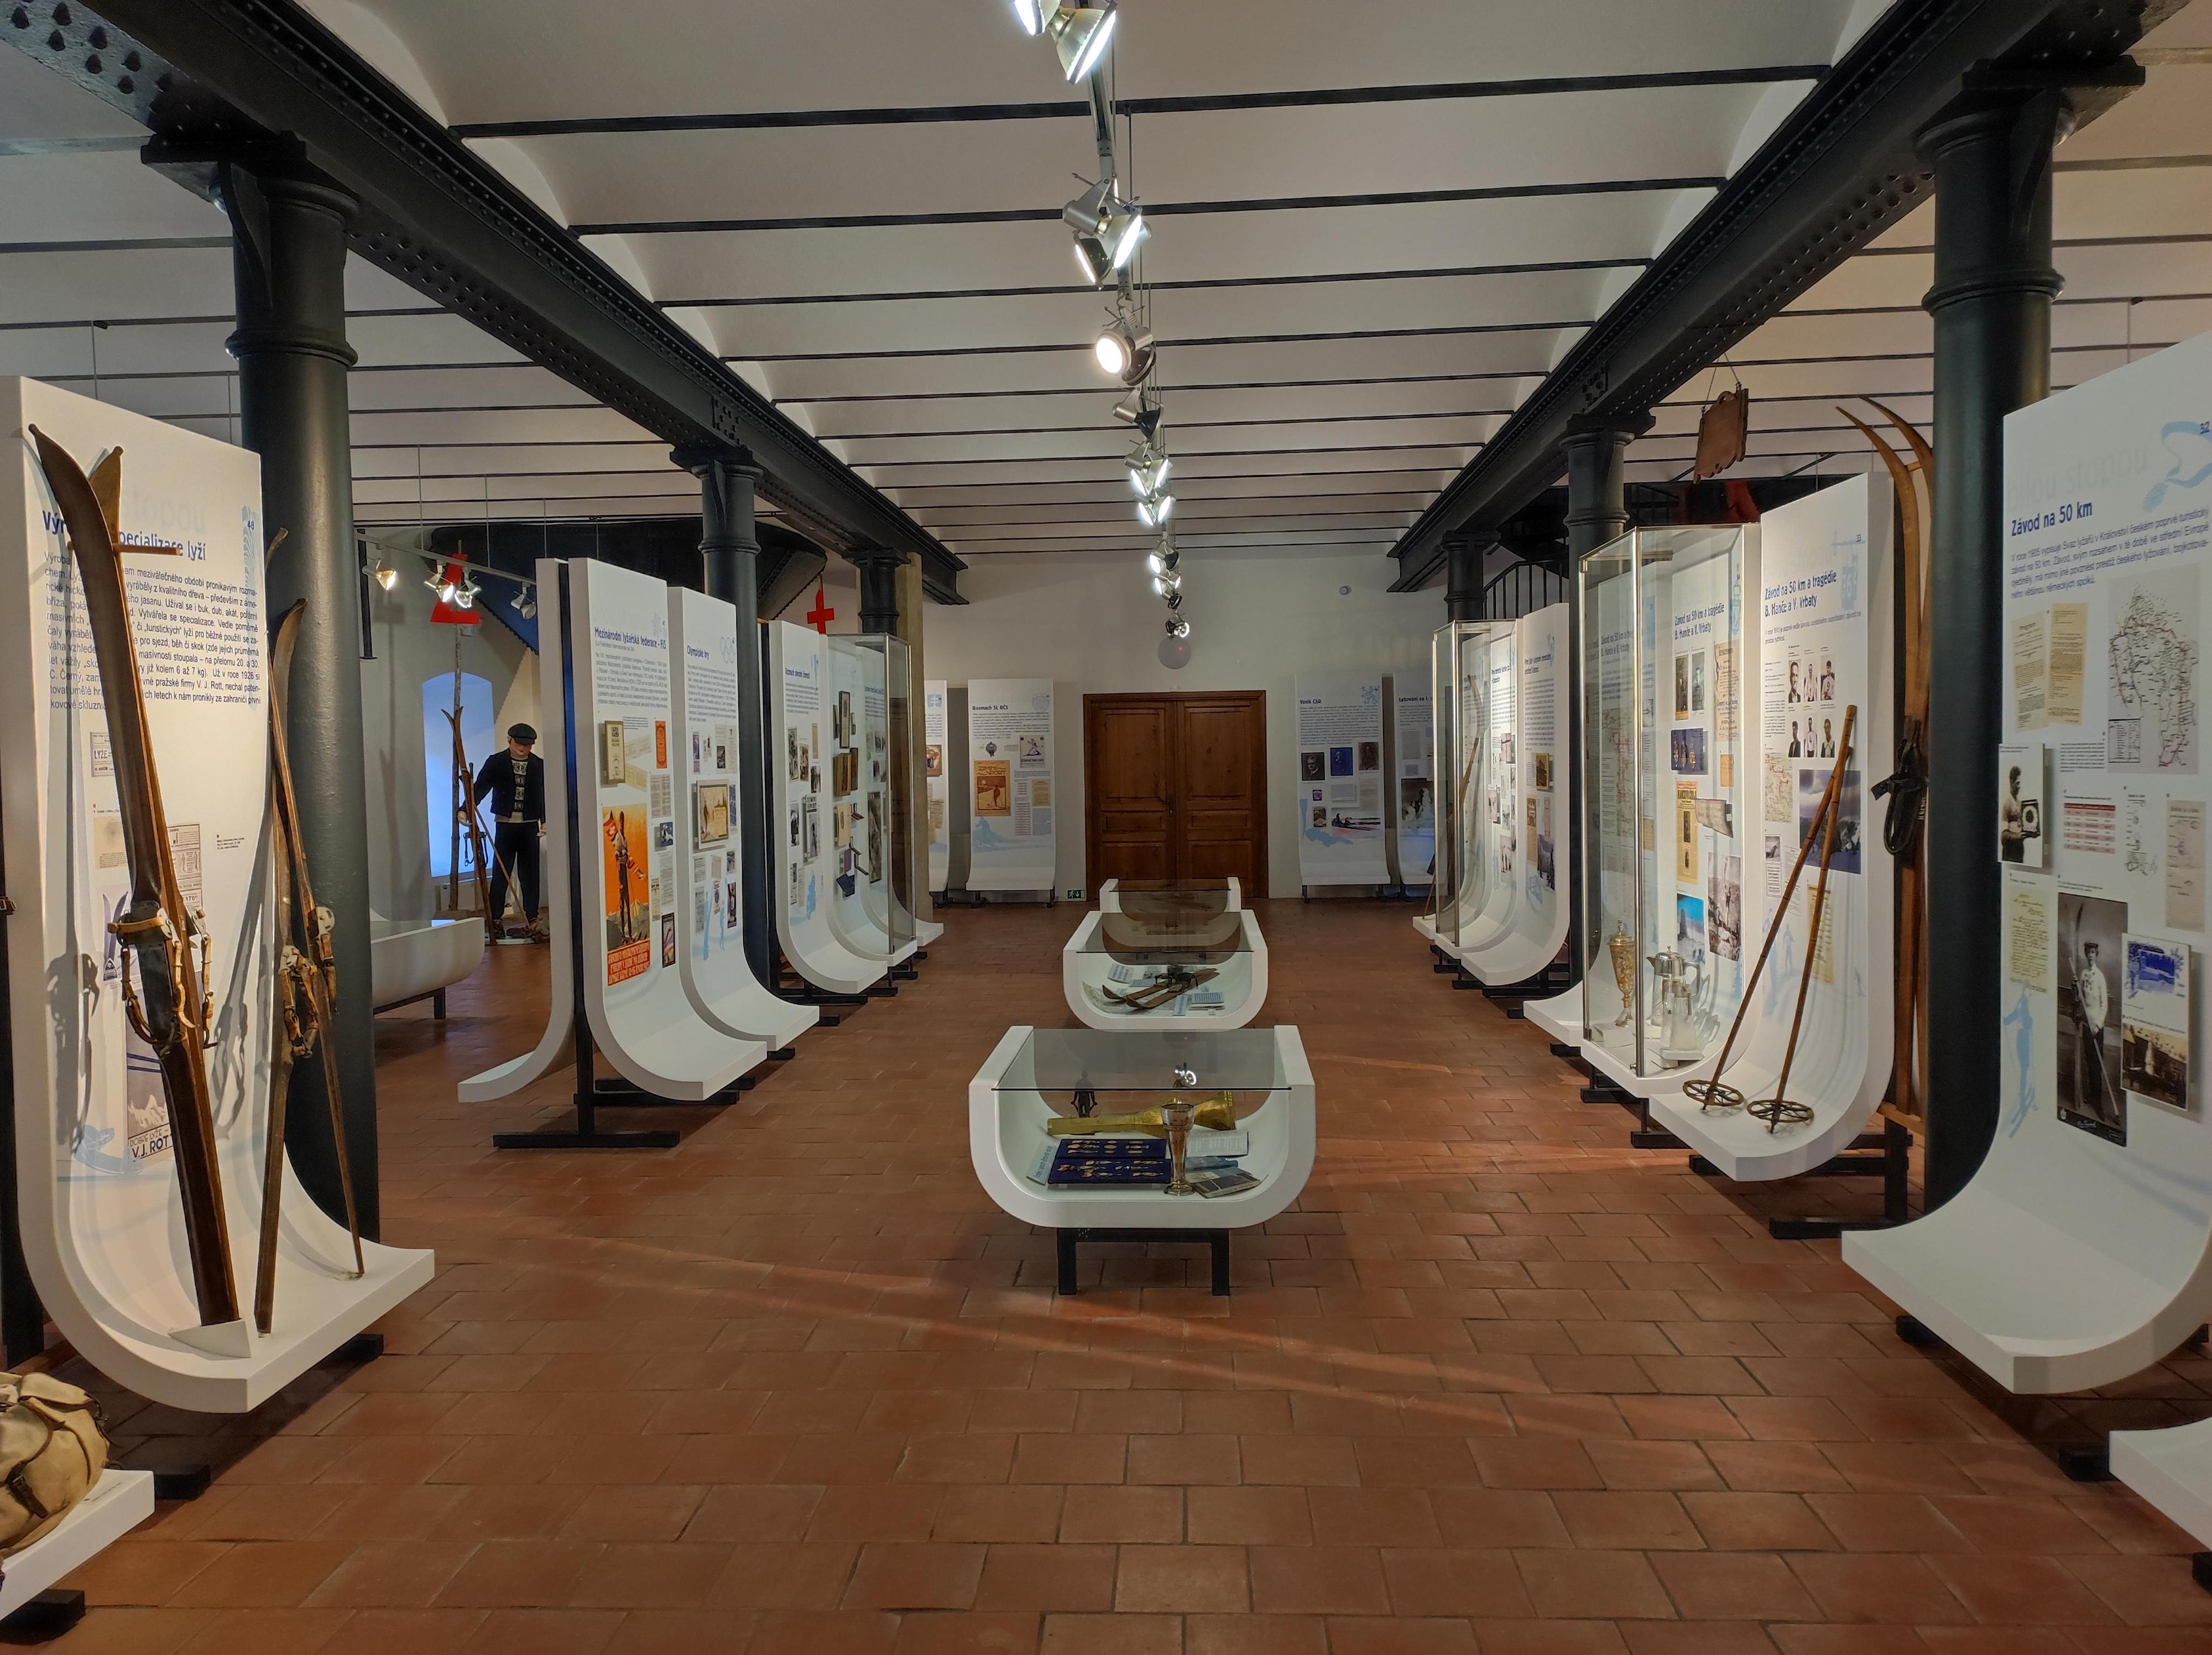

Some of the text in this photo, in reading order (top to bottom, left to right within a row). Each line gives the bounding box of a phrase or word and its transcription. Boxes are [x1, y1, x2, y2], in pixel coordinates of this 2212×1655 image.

[247, 520, 254, 530] 48
[2011, 501, 2093, 536] Závod na 50 km
[43, 510, 65, 535] Výr
[187, 540, 206, 562] lyží
[44, 551, 71, 565] Výroba
[137, 570, 182, 583] meziválečného
[206, 581, 237, 594] pronikavým
[239, 587, 257, 596] rozma-
[1765, 570, 1837, 601] Závod na 50 km a tragédie
[45, 567, 67, 578] chem.
[70, 570, 82, 582] Lyž
[126, 581, 152, 594] vyráběly
[159, 584, 187, 597] kvalitního
[188, 589, 204, 599] dřeva
[211, 593, 238, 605] především
[244, 599, 257, 608] ame-
[46, 581, 63, 593] rické
[66, 584, 85, 596] hicko
[140, 595, 163, 607] jasanu.
[198, 603, 210, 614] buk,
[212, 605, 224, 617] dub,
[225, 608, 238, 618] akát,
[46, 596, 67, 608] bříza,
[138, 608, 167, 620] Vytvářela
[180, 615, 216, 627] specializace.
[218, 619, 233, 629] Vedle
[1674, 614, 1686, 626] Závod
[1686, 614, 1691, 623] na
[1692, 610, 1697, 620] 50
[1698, 609, 1703, 619] km
[1708, 603, 1724, 617] tragédie
[1765, 594, 1818, 617] B. Hanče a V. Vrbaty
[47, 612, 85, 624] masivních
[137, 622, 142, 631] či
[184, 627, 193, 639] lyží
[195, 630, 204, 639] pro
[206, 630, 222, 640] běžné
[594, 627, 622, 641] Mezinárodní
[623, 632, 640, 645] lyžařská
[640, 636, 658, 648] federace
[48, 626, 62, 638] čaly
[140, 637, 150, 646] pro
[152, 637, 170, 648] sjezd,
[171, 639, 182, 648] běh
[184, 640, 189, 649] či
[191, 641, 204, 650] skok
[206, 643, 218, 653] (zde
[219, 645, 233, 655] jejich
[234, 646, 259, 656] průměrná
[48, 641, 66, 651] váha
[69, 644, 96, 653] vzhlede
[139, 650, 171, 660] masivnosti
[174, 652, 198, 665] stoupala
[213, 656, 236, 666] přelomu
[237, 658, 246, 667] 20.
[251, 660, 259, 669] 30.
[49, 654, 58, 665] let
[60, 656, 81, 669] vážily
[156, 664, 174, 674] kolem
[176, 665, 180, 674] 6
[182, 667, 190, 675] až
[191, 667, 195, 675] 7
[197, 667, 208, 678] kg).
[212, 668, 220, 677] Už
[241, 671, 254, 680] 1926
[49, 669, 58, 679] C.
[60, 668, 84, 683] Černý,
[155, 677, 179, 687] pražské
[181, 678, 195, 690] firmy
[196, 680, 202, 689] V.
[204, 680, 209, 690] J.
[211, 681, 223, 691] Rott,
[225, 682, 243, 691] nechal
[244, 683, 260, 693] paten-
[50, 685, 68, 695] tovat
[70, 686, 91, 696] umělé
[93, 686, 103, 696] hra
[154, 690, 172, 699] letech
[174, 691, 177, 700] k
[179, 692, 191, 701] nám
[192, 693, 214, 704] pronikly
[50, 700, 76, 709] kovové
[94, 749, 108, 759] LYŽE
[150, 1134, 172, 1153] ROT
